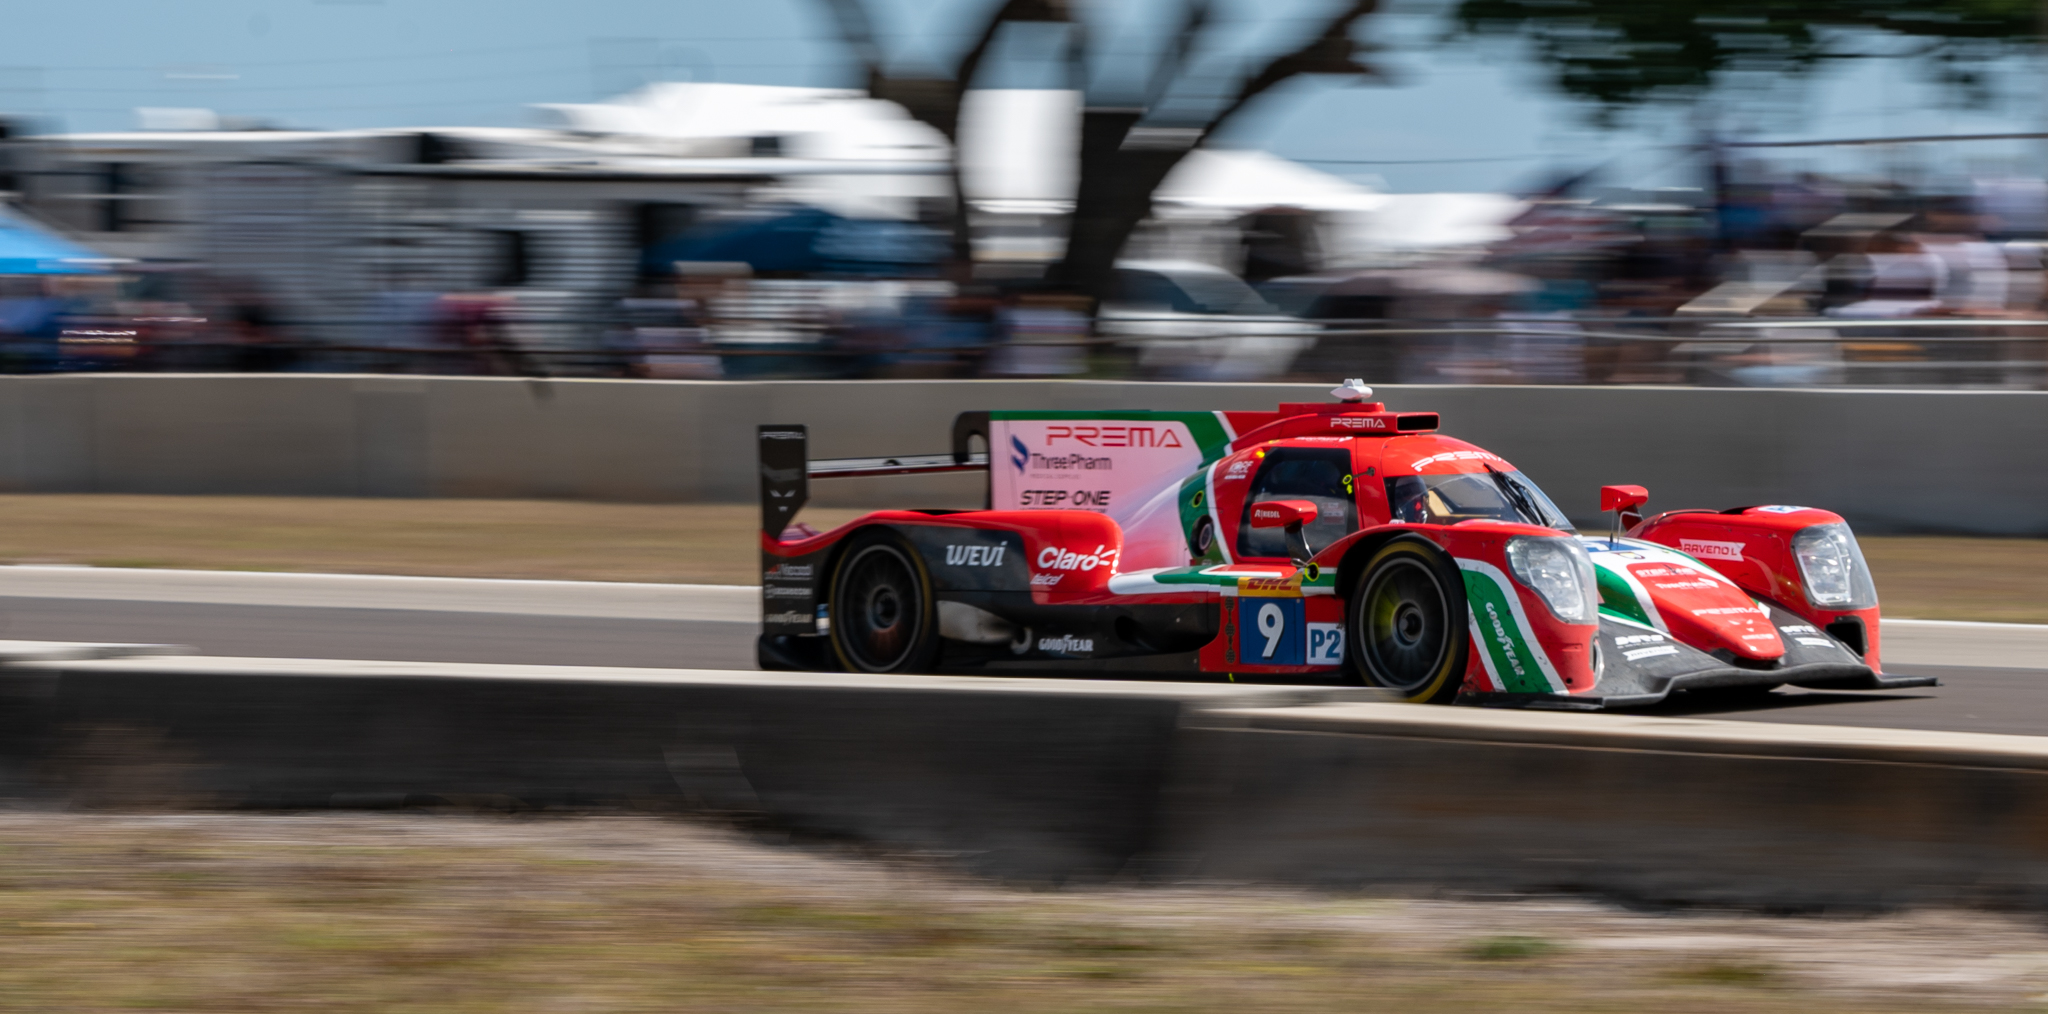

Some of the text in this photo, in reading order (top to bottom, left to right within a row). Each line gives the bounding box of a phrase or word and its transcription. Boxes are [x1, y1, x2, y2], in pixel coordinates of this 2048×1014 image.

[1331, 418, 1386, 428] PREMA
[1046, 426, 1182, 448] PREMA
[1246, 579, 1292, 590] DHL
[1258, 603, 1284, 659] 9
[1486, 602, 1525, 676] GOODYEAR
[1038, 634, 1093, 653] GOODYEAR
[1310, 629, 1341, 658] P2
